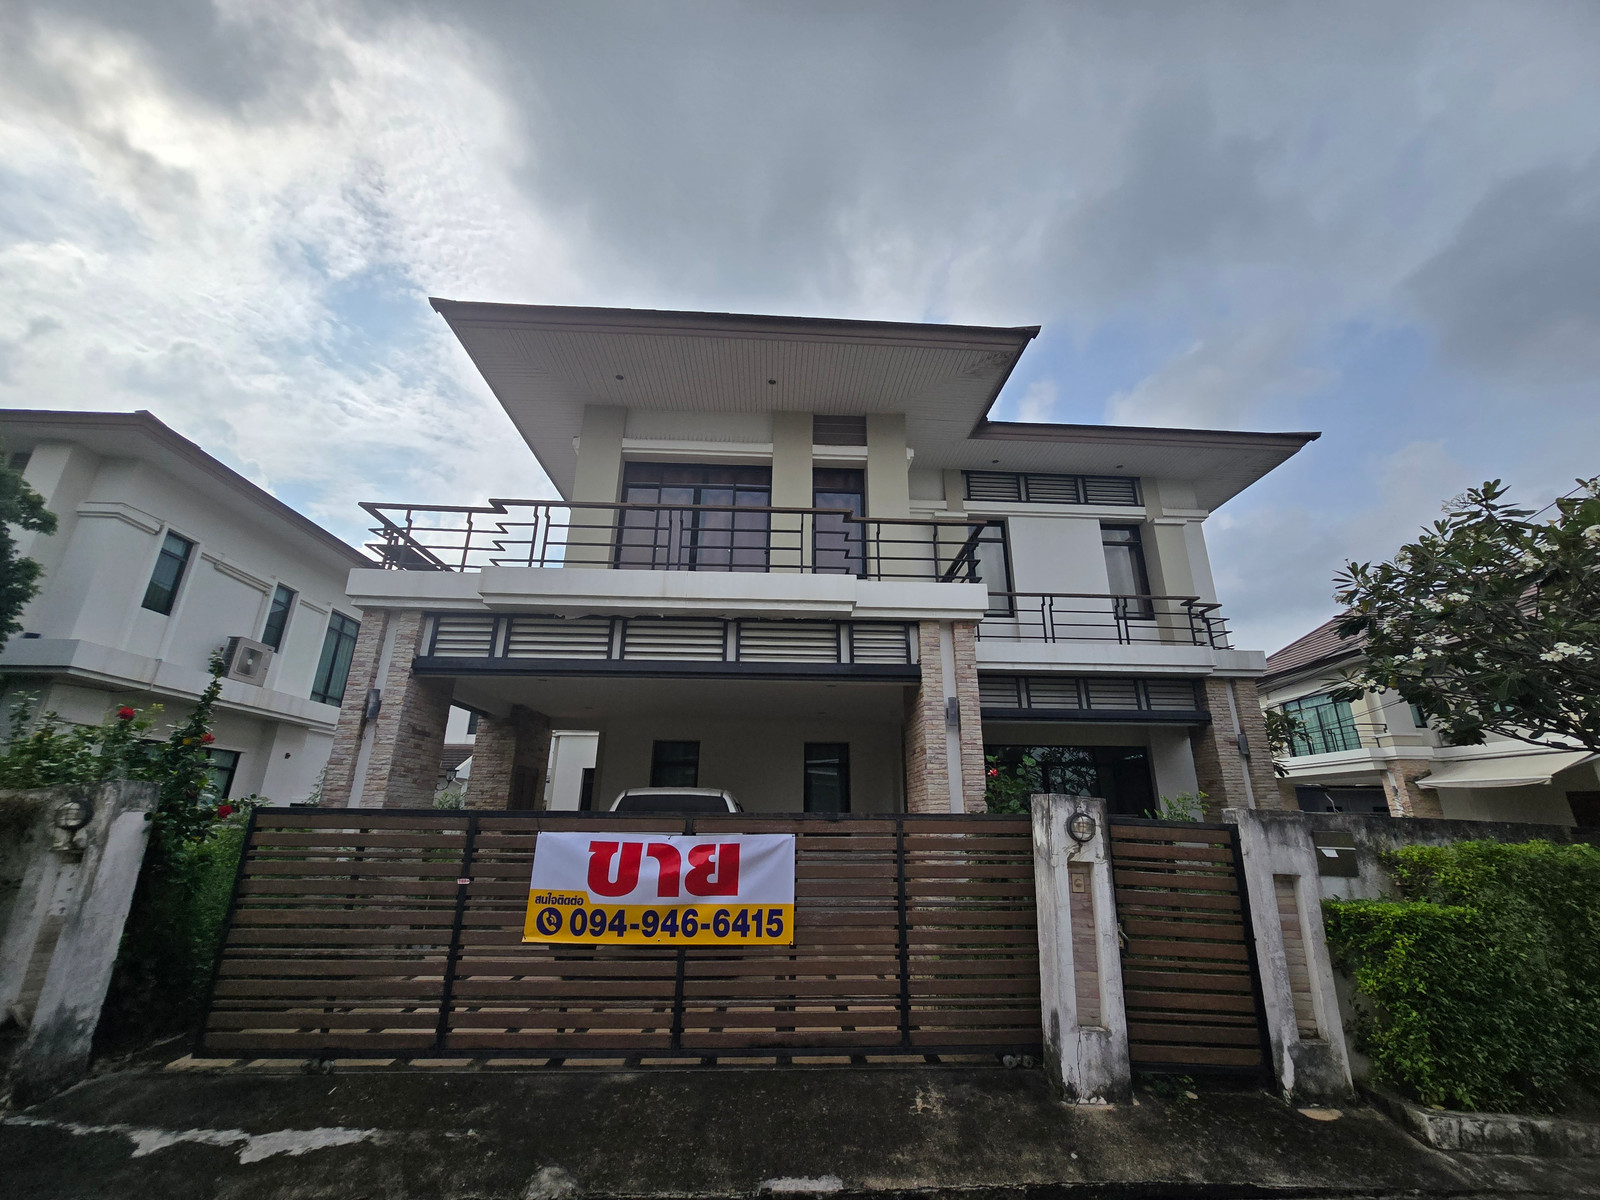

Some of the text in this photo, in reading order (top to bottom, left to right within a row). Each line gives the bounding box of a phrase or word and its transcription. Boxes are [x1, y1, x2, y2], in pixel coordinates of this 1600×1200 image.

[587, 841, 740, 897] ขาย
[535, 892, 584, 906] สนใจติดต่อ
[569, 908, 784, 938] 094-946-6415
